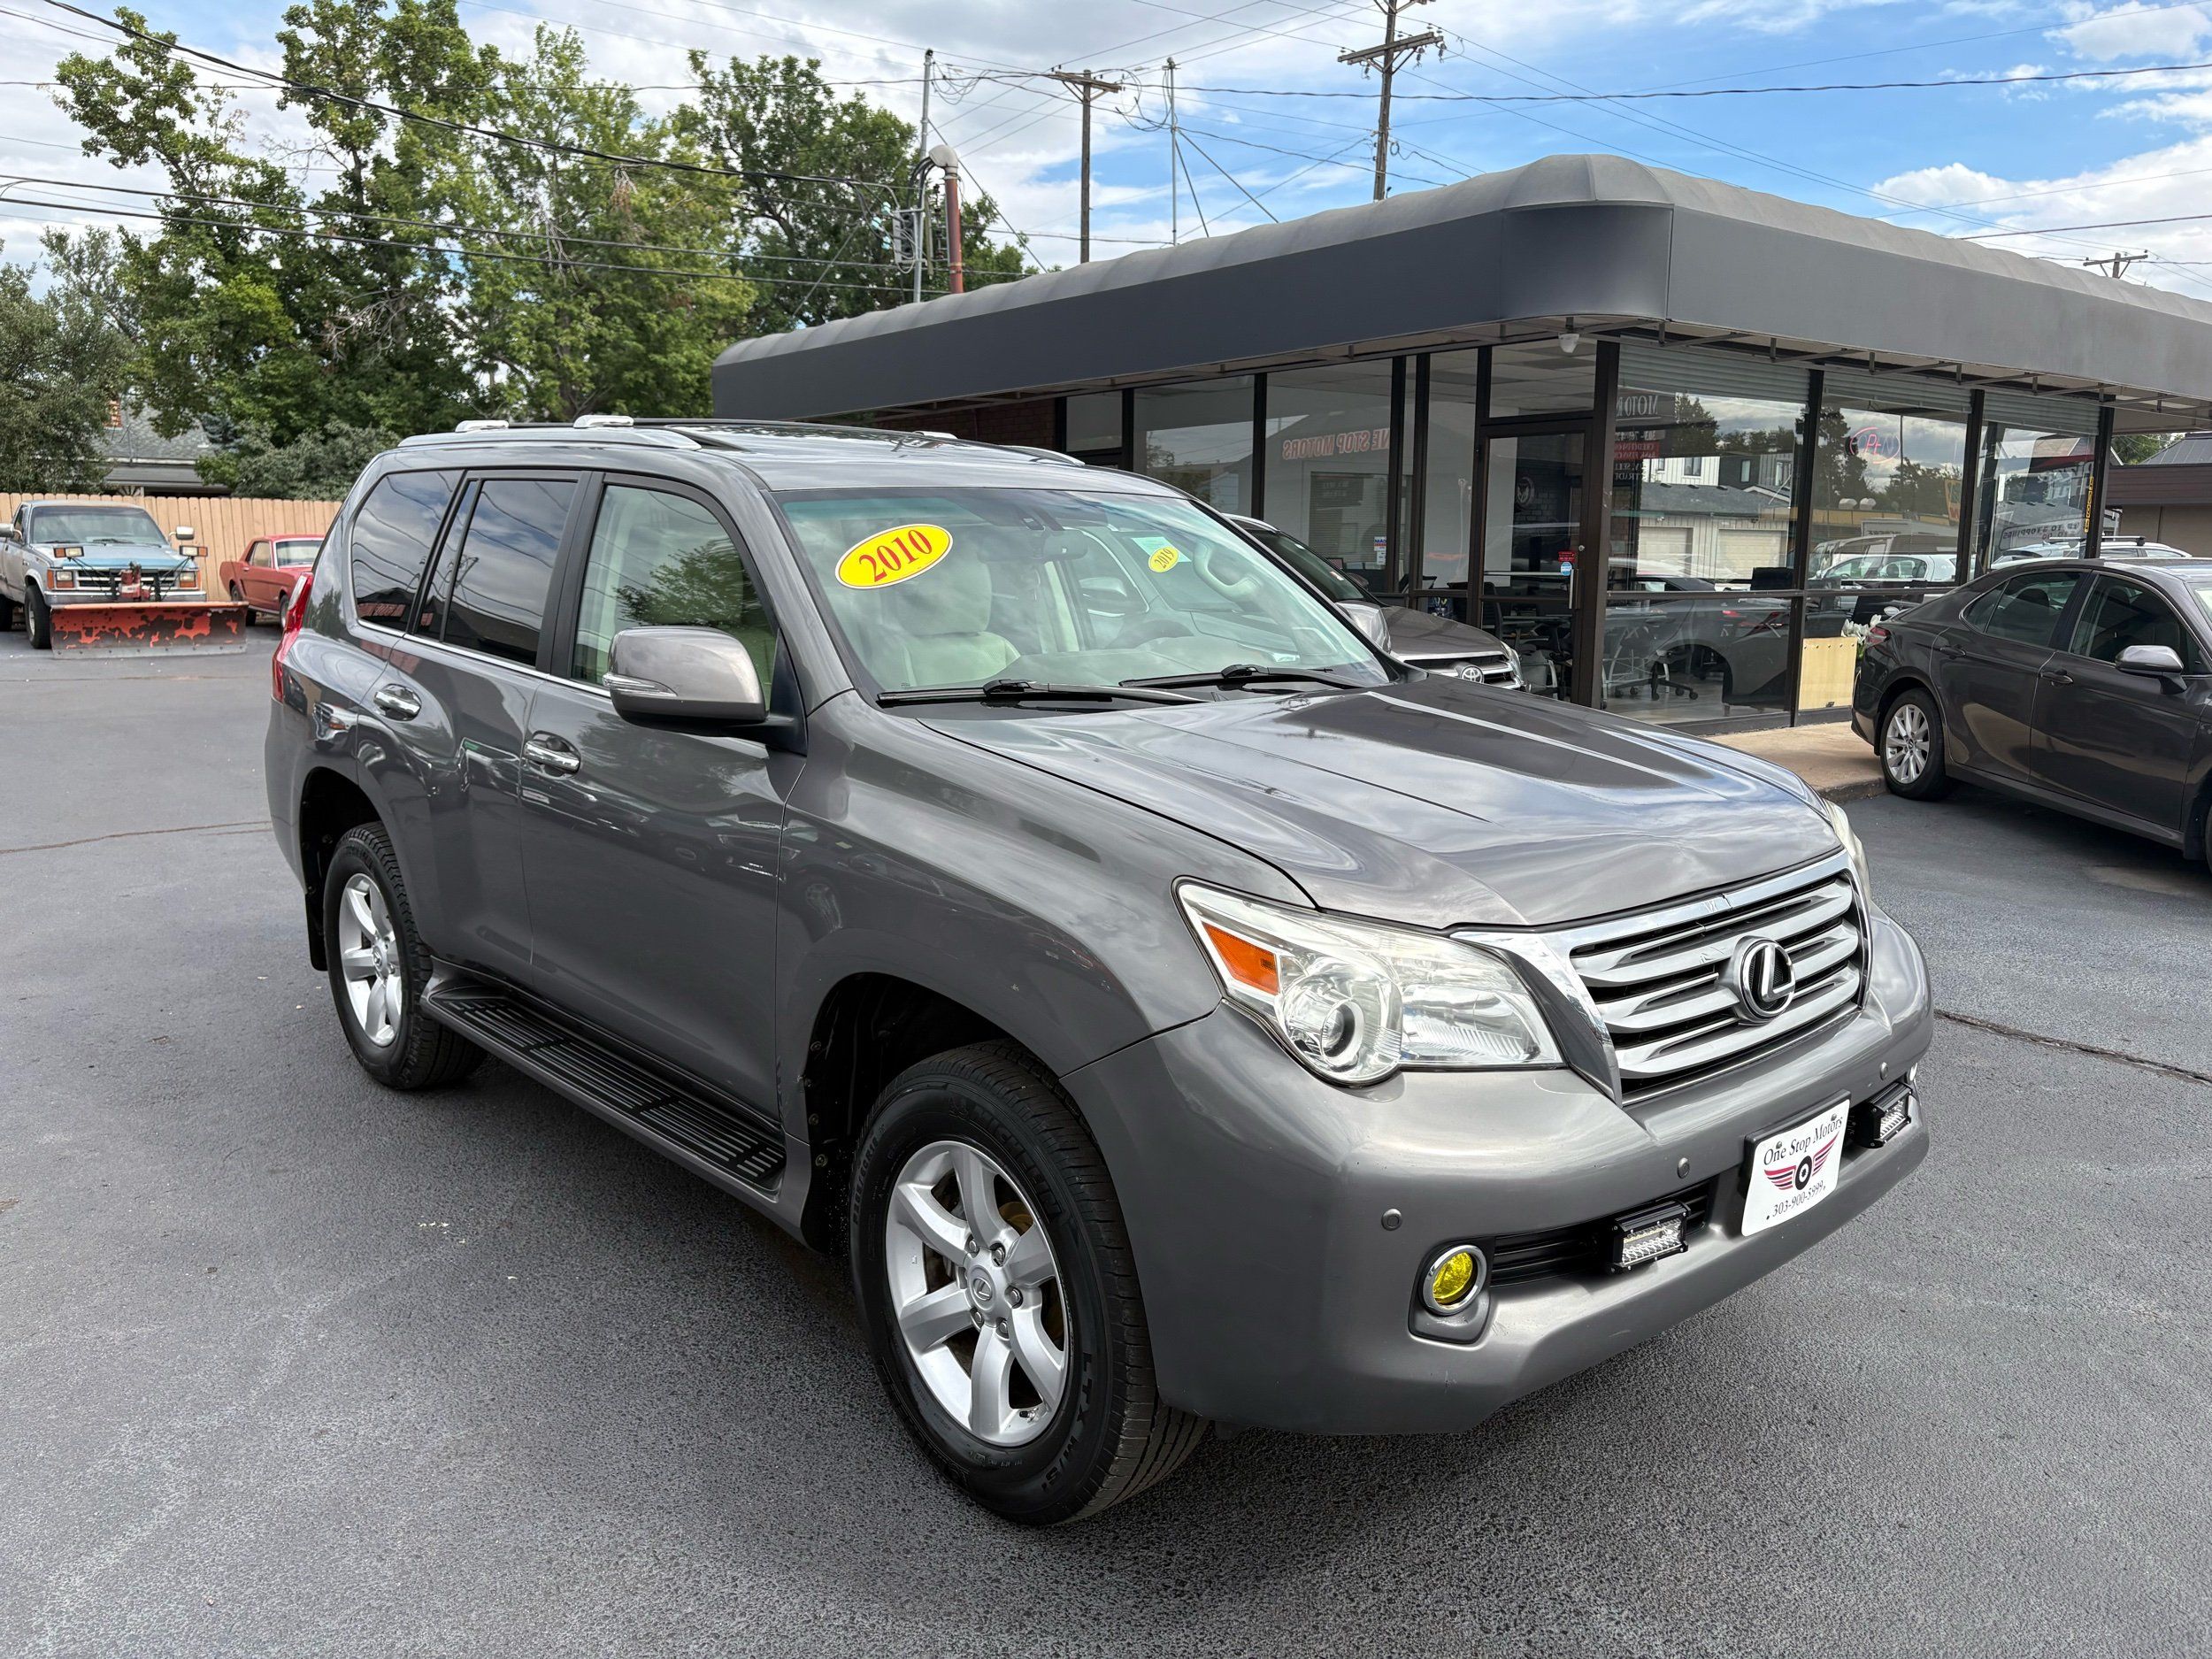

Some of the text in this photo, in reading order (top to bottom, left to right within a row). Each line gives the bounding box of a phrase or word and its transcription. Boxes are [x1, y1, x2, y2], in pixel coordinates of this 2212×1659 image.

[858, 529, 933, 582] 2010
[1763, 1117, 1843, 1165] One Stop Motors
